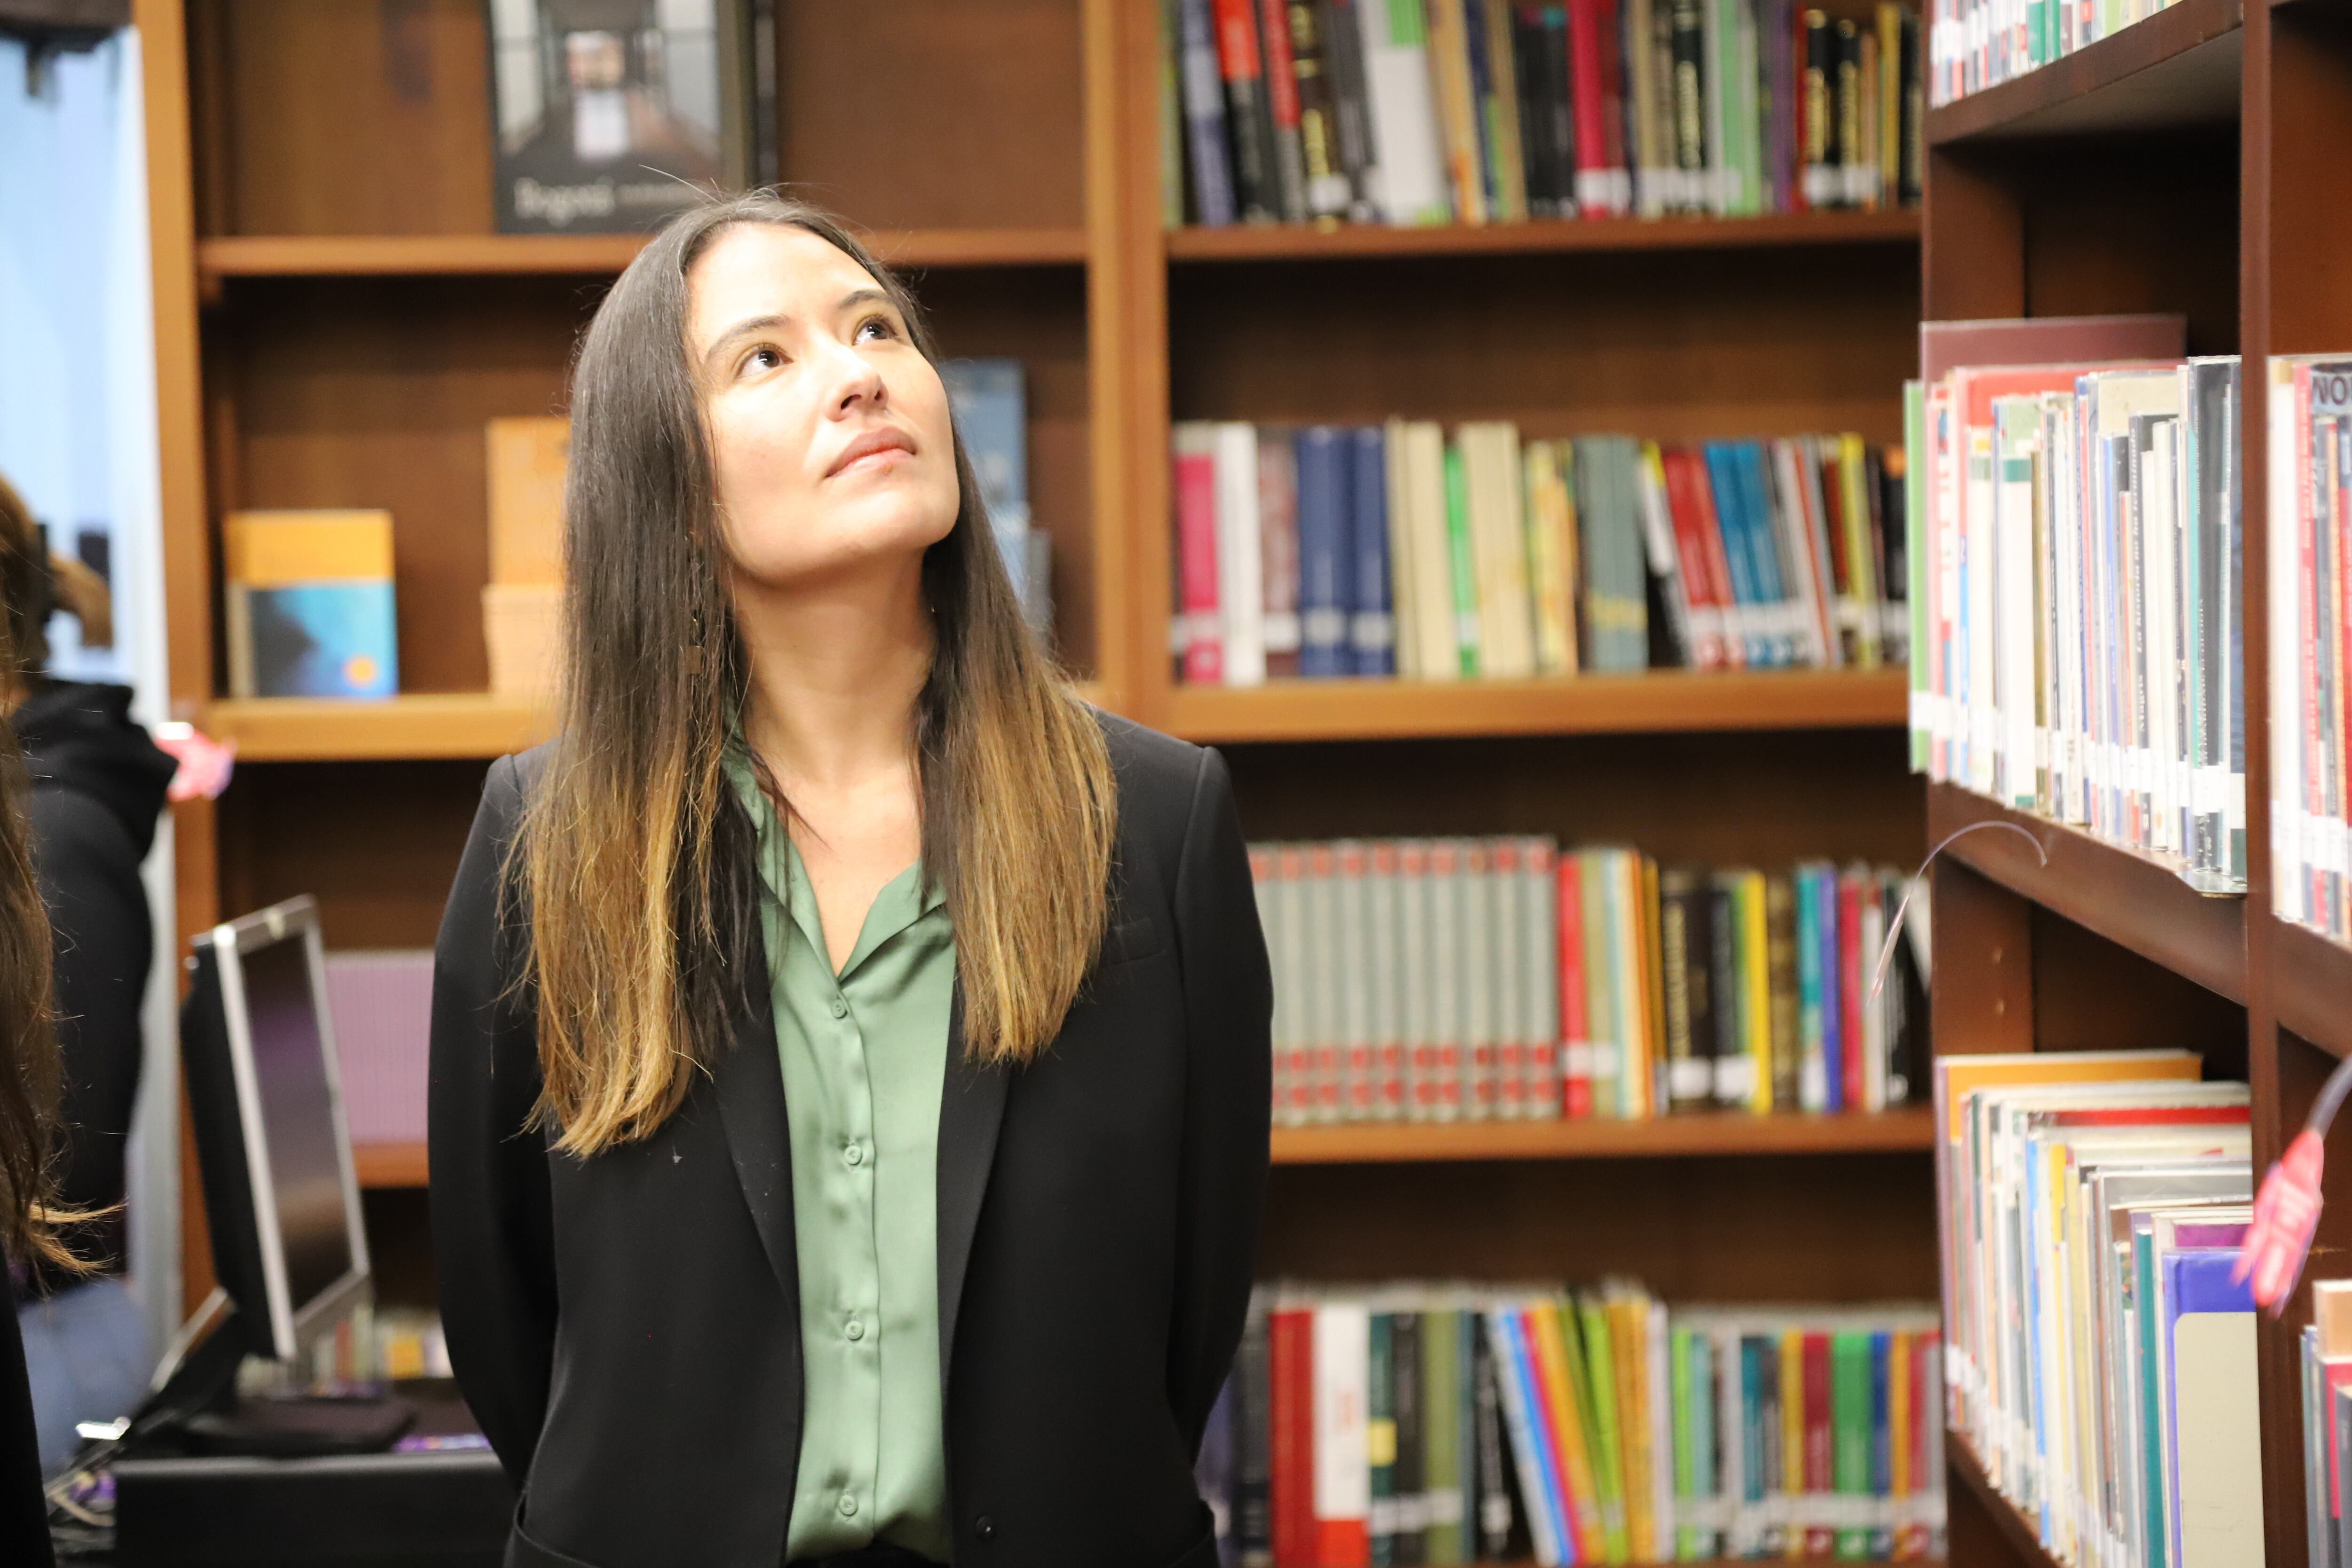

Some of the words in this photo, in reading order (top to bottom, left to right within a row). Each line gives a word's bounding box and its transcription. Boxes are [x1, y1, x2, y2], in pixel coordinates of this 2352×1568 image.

[2313, 376, 2352, 405] NO
[2132, 517, 2138, 535] ha
[2133, 541, 2139, 560] no
[2136, 632, 2142, 653] La
